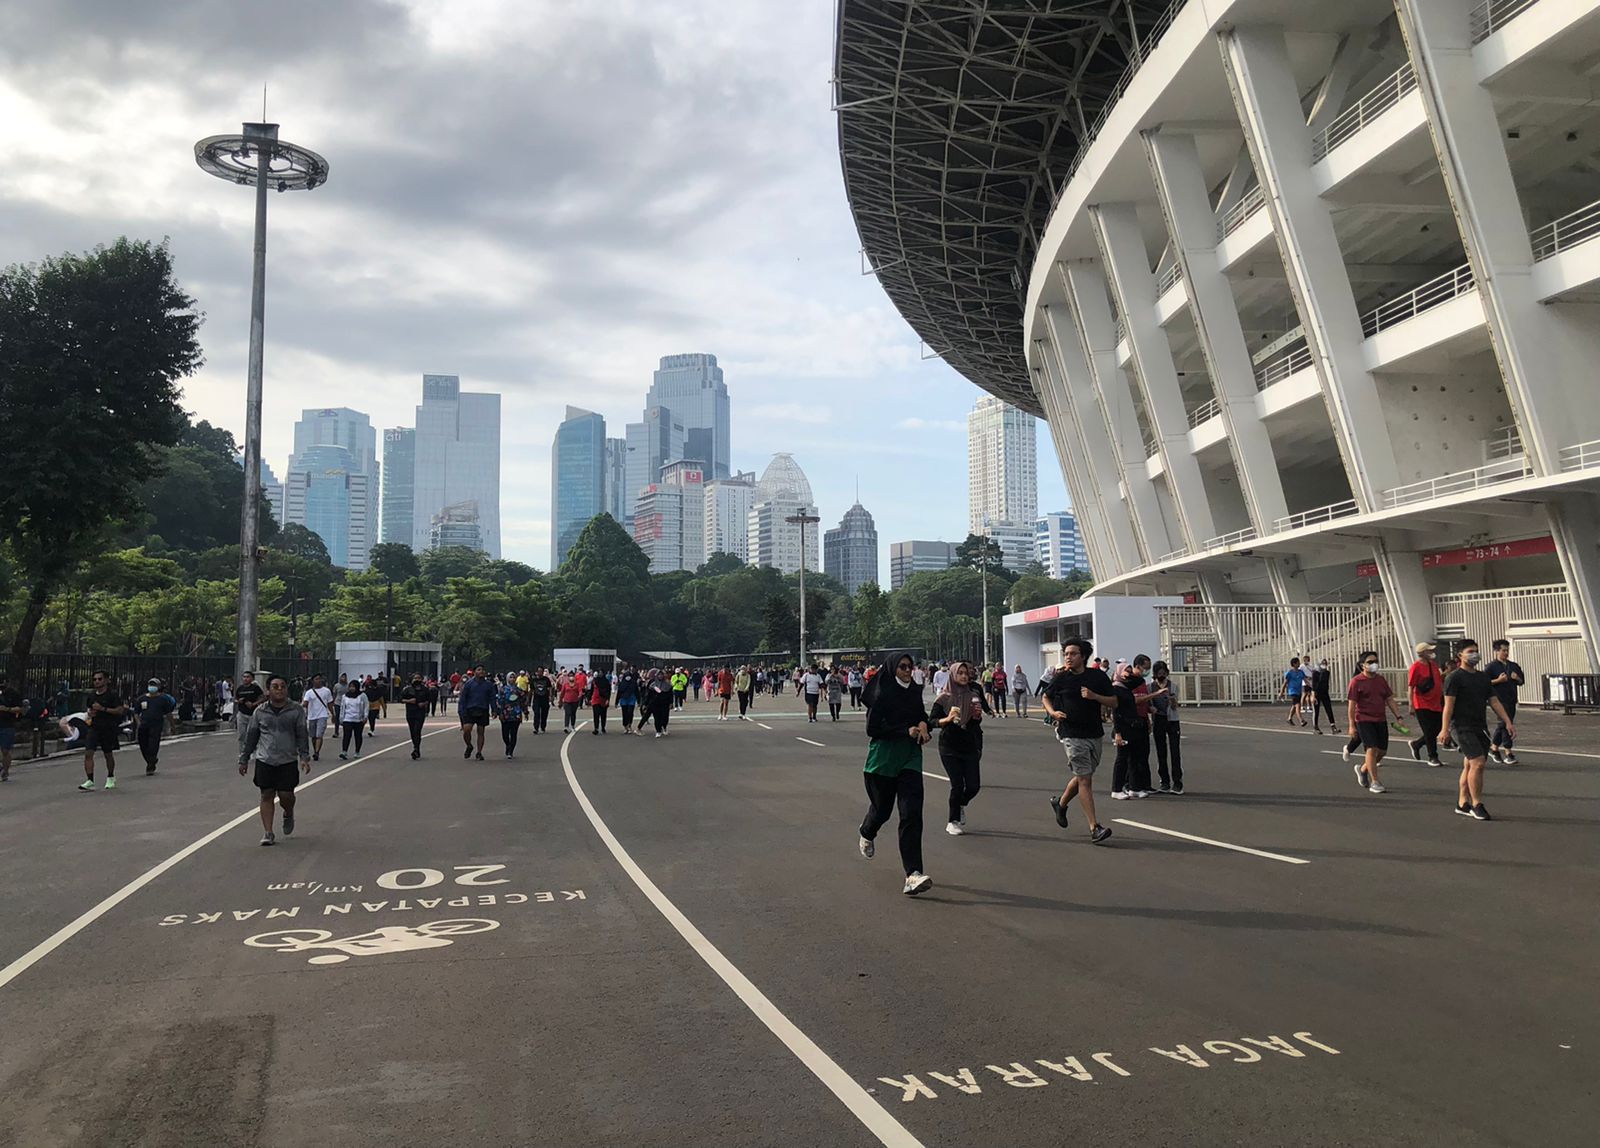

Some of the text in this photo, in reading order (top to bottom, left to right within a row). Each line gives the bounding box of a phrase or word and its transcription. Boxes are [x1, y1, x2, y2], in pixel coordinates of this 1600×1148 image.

[265, 864, 511, 897] 20 km/jam
[158, 888, 587, 927] KECEPATAN MAKS
[876, 1031, 1341, 1103] JAGA JARAK
